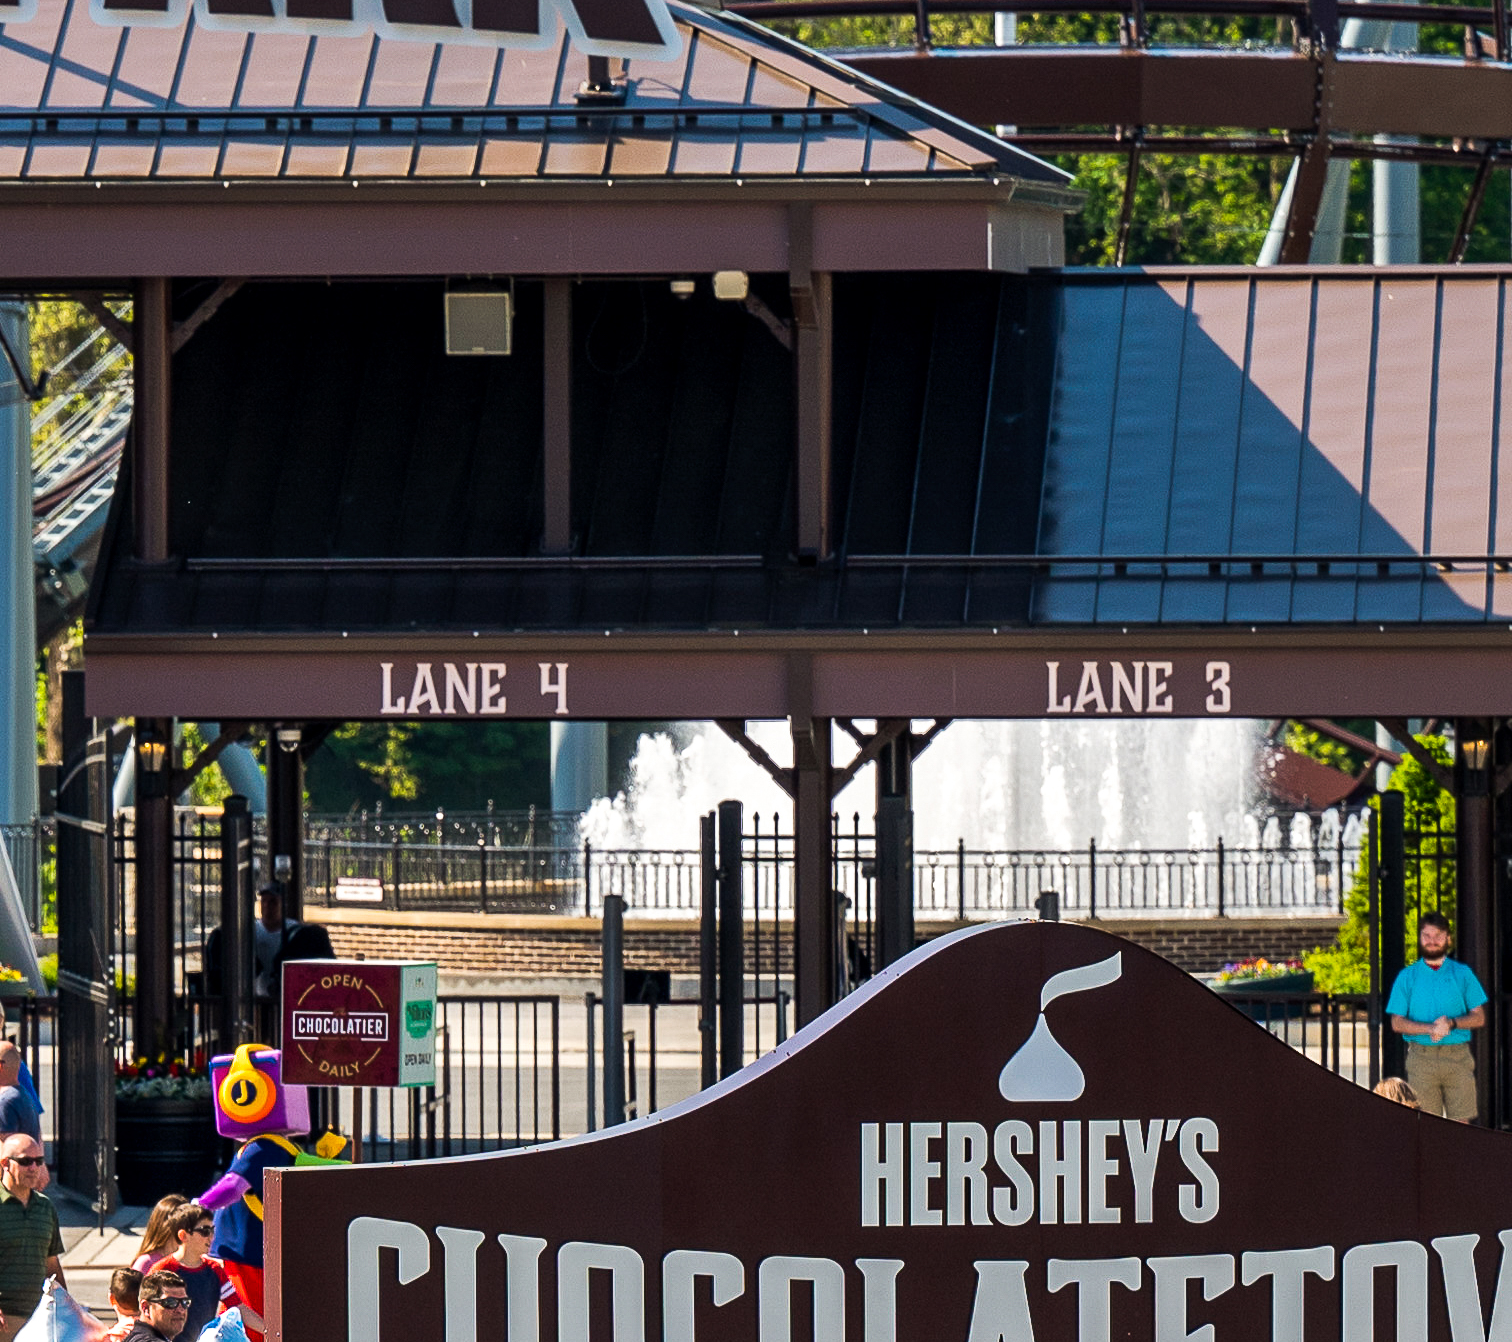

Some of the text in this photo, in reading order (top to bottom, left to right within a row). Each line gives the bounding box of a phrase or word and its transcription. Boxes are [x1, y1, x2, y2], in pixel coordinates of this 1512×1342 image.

[380, 662, 569, 714] LANE 4
[1046, 661, 1231, 713] LANE 3
[320, 974, 363, 990] OPEN
[298, 1017, 383, 1035] CHOCOLATIER
[318, 1060, 361, 1077] DAILY
[859, 1116, 1221, 1228] HERSHEY'S
